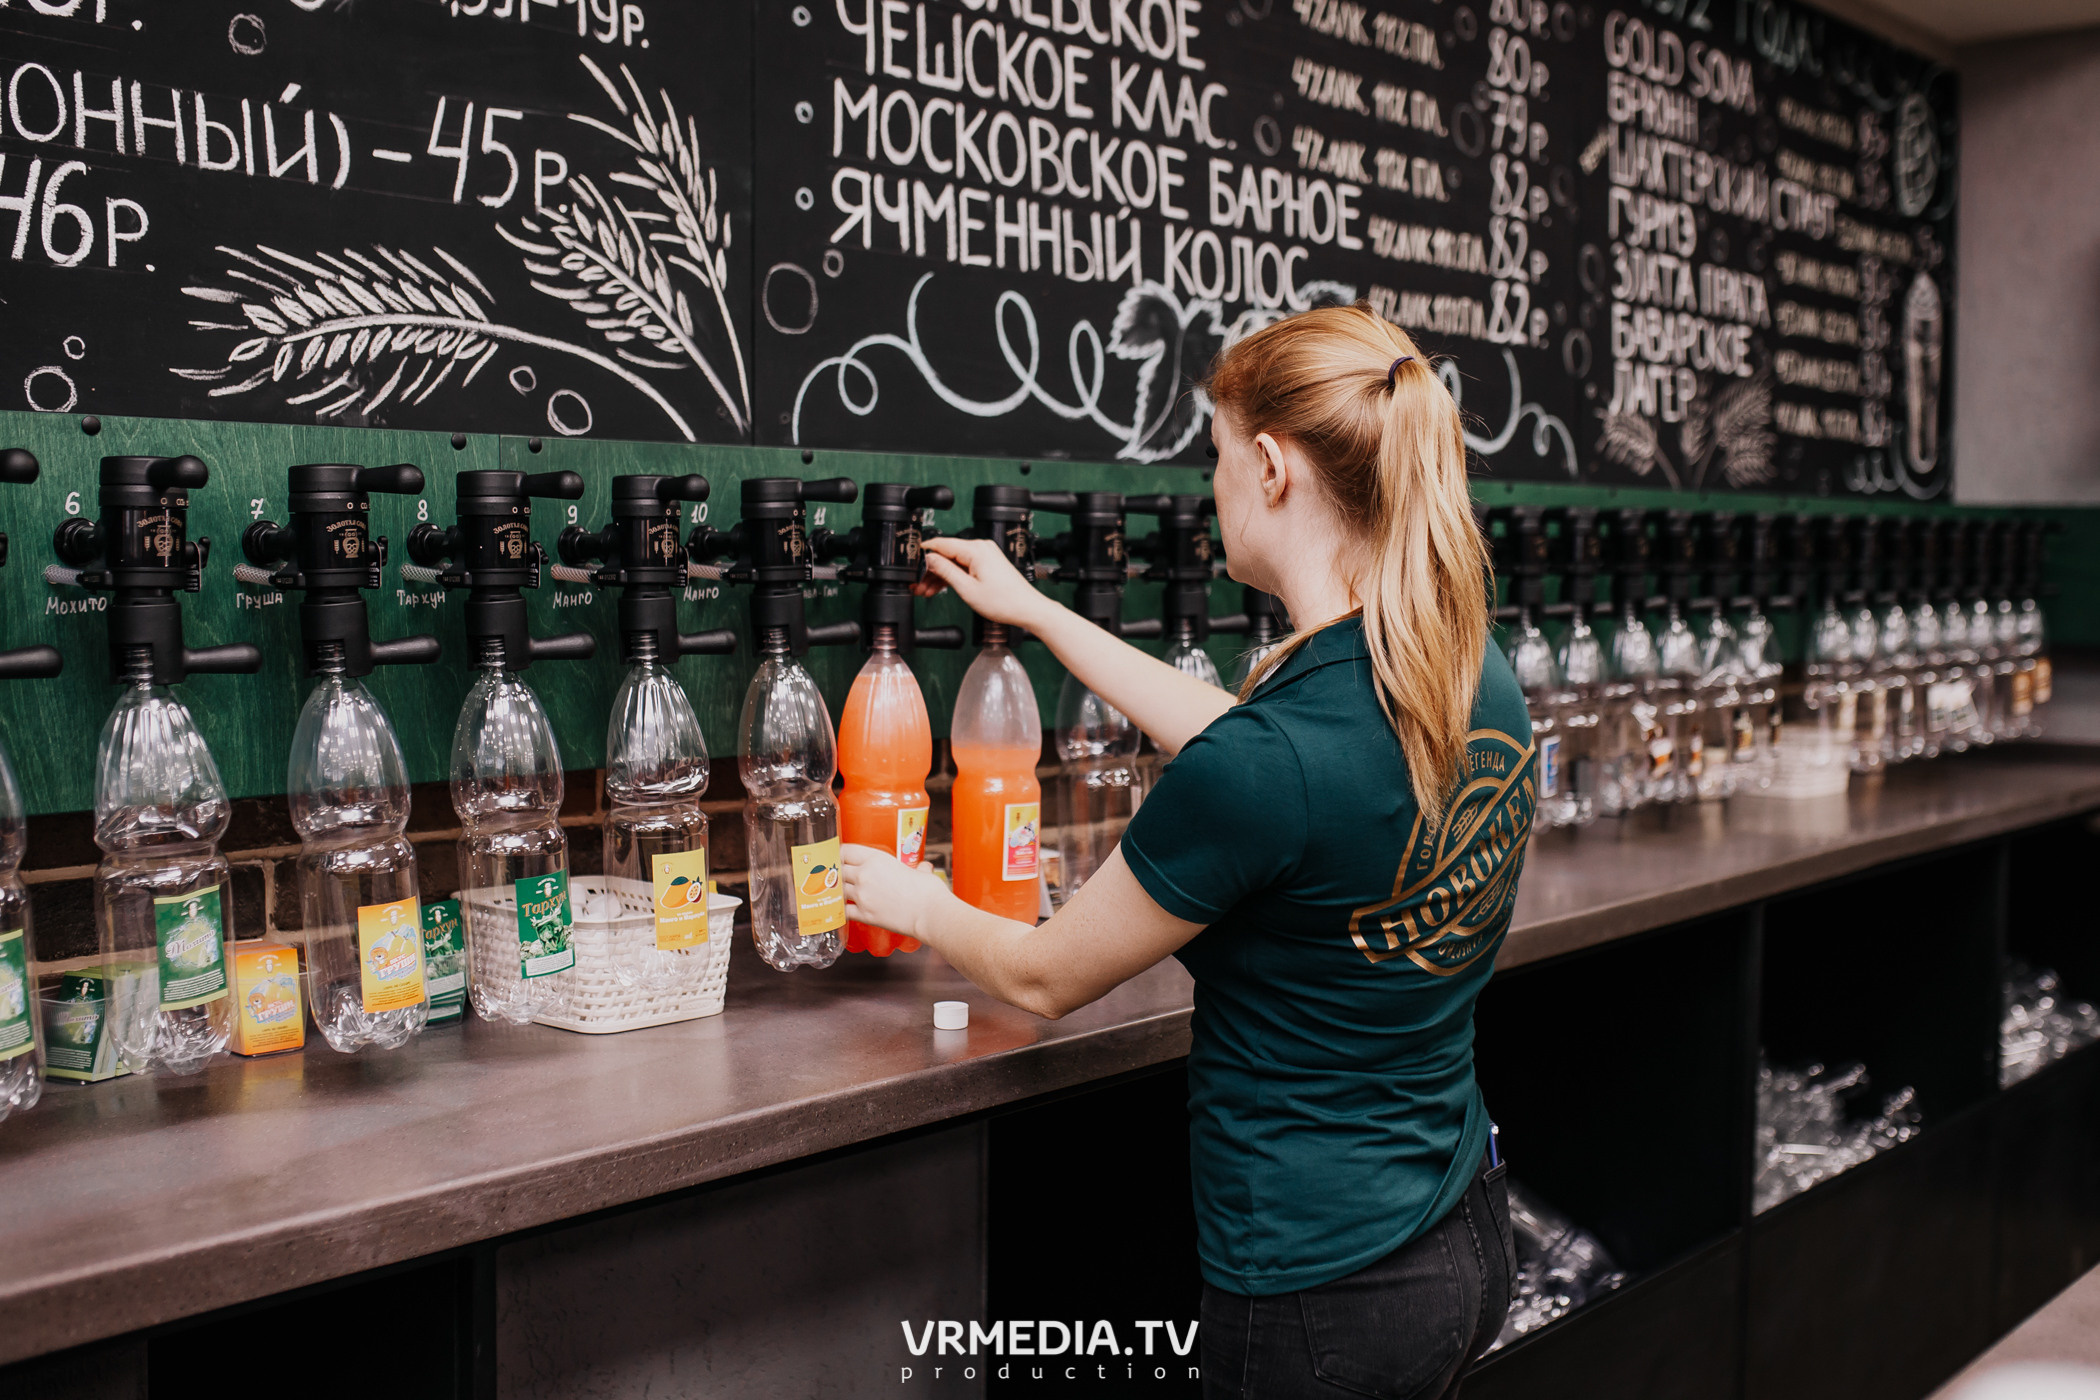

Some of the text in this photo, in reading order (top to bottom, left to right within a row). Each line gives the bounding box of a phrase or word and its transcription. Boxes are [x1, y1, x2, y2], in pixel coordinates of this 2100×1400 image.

[1604, 9, 1684, 86] GOLD
[837, 0, 1094, 119] ЧЕШСКОЕ
[1111, 57, 1238, 151] КЛАС.
[833, 77, 1190, 220] МОСКОВСКОЕ
[1209, 157, 1364, 250] БАРНОЕ
[830, 166, 1142, 284] ЯЧМЕННЫЙ
[1164, 223, 1312, 312] КОЛОС
[65, 491, 81, 515] 6
[250, 497, 265, 519] 7
[416, 499, 429, 521] 8
[567, 504, 579, 525] 9
[691, 502, 708, 524] 10
[521, 890, 567, 918] Тархун
